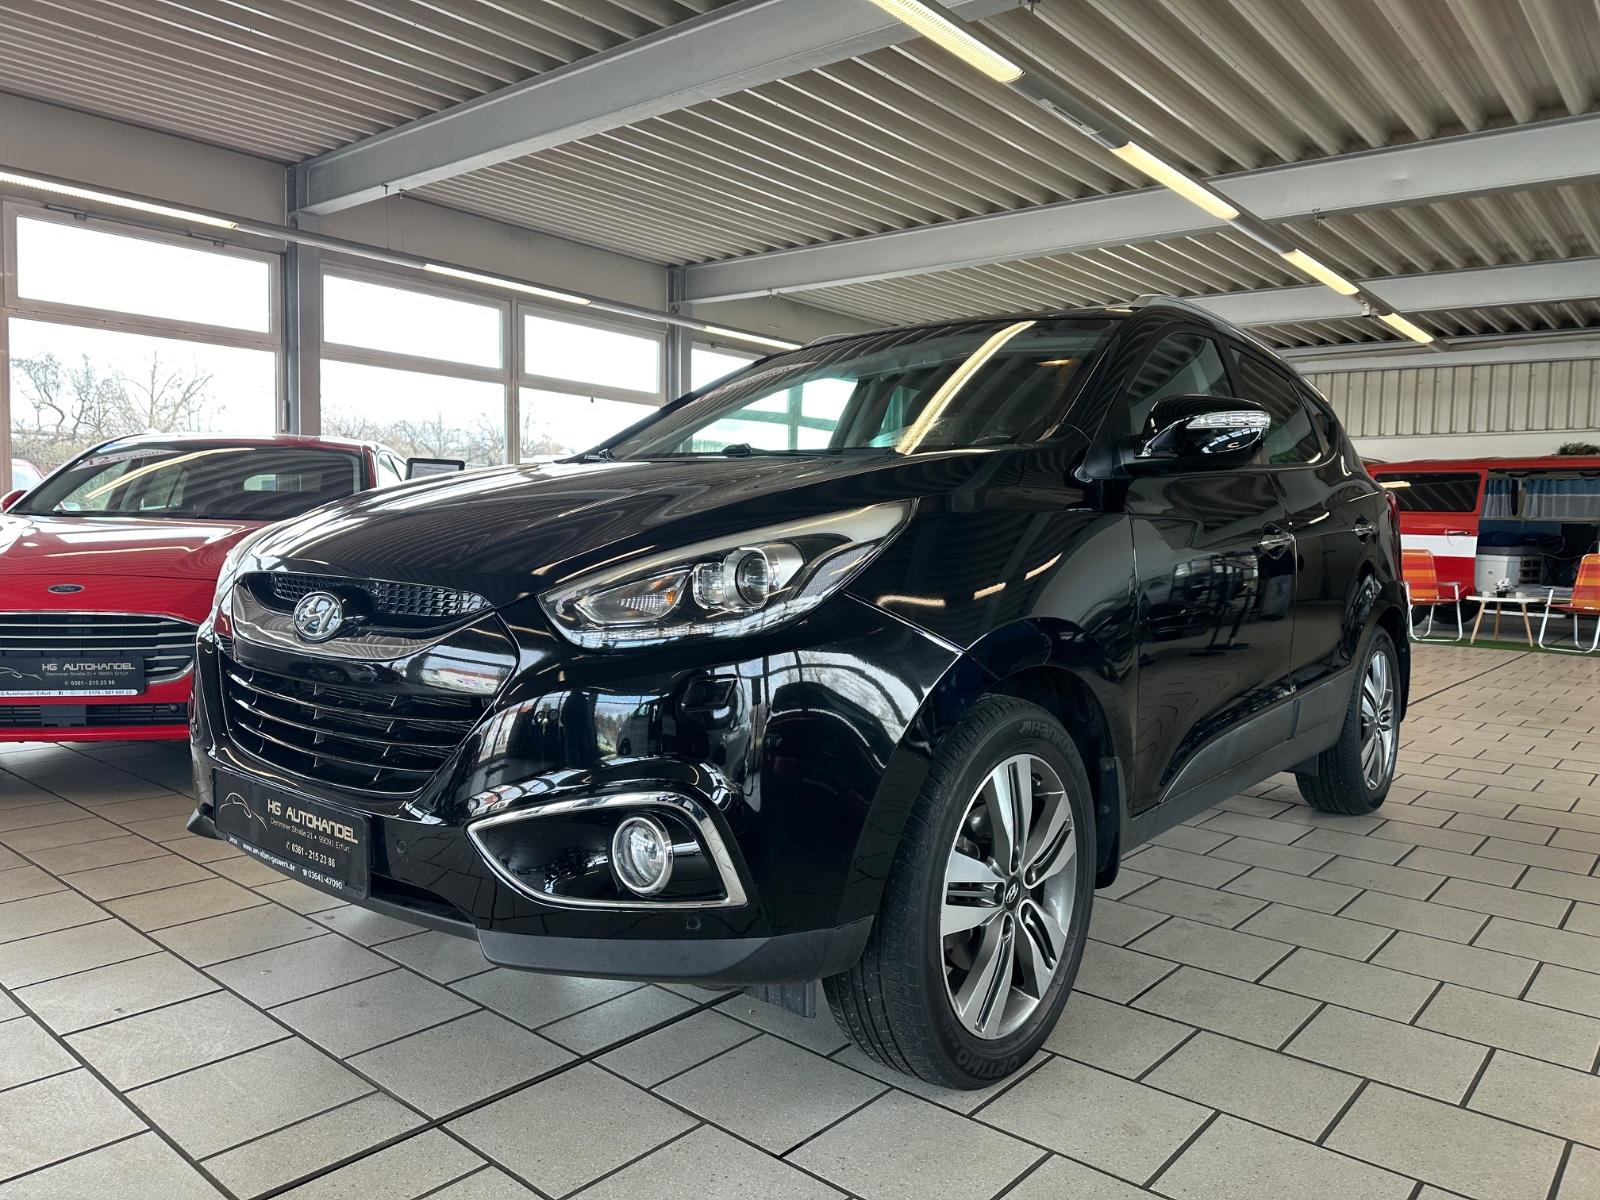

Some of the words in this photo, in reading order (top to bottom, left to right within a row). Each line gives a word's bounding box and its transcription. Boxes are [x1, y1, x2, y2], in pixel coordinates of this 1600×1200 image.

[41, 663, 58, 671] HG
[63, 662, 136, 671] AUTOHANDEL
[267, 798, 282, 816] HG
[286, 806, 359, 844] AUTOHANDEL
[291, 825, 307, 838] Straße
[306, 831, 313, 840] 21
[318, 835, 334, 848] 99091
[335, 841, 351, 855] Erfurt
[291, 843, 305, 857] 0361
[308, 849, 319, 862] 215
[319, 854, 328, 865] 23
[327, 857, 337, 868] 86
[307, 869, 343, 890] 03641-47090
[955, 1049, 1020, 1079] OPTIMO
